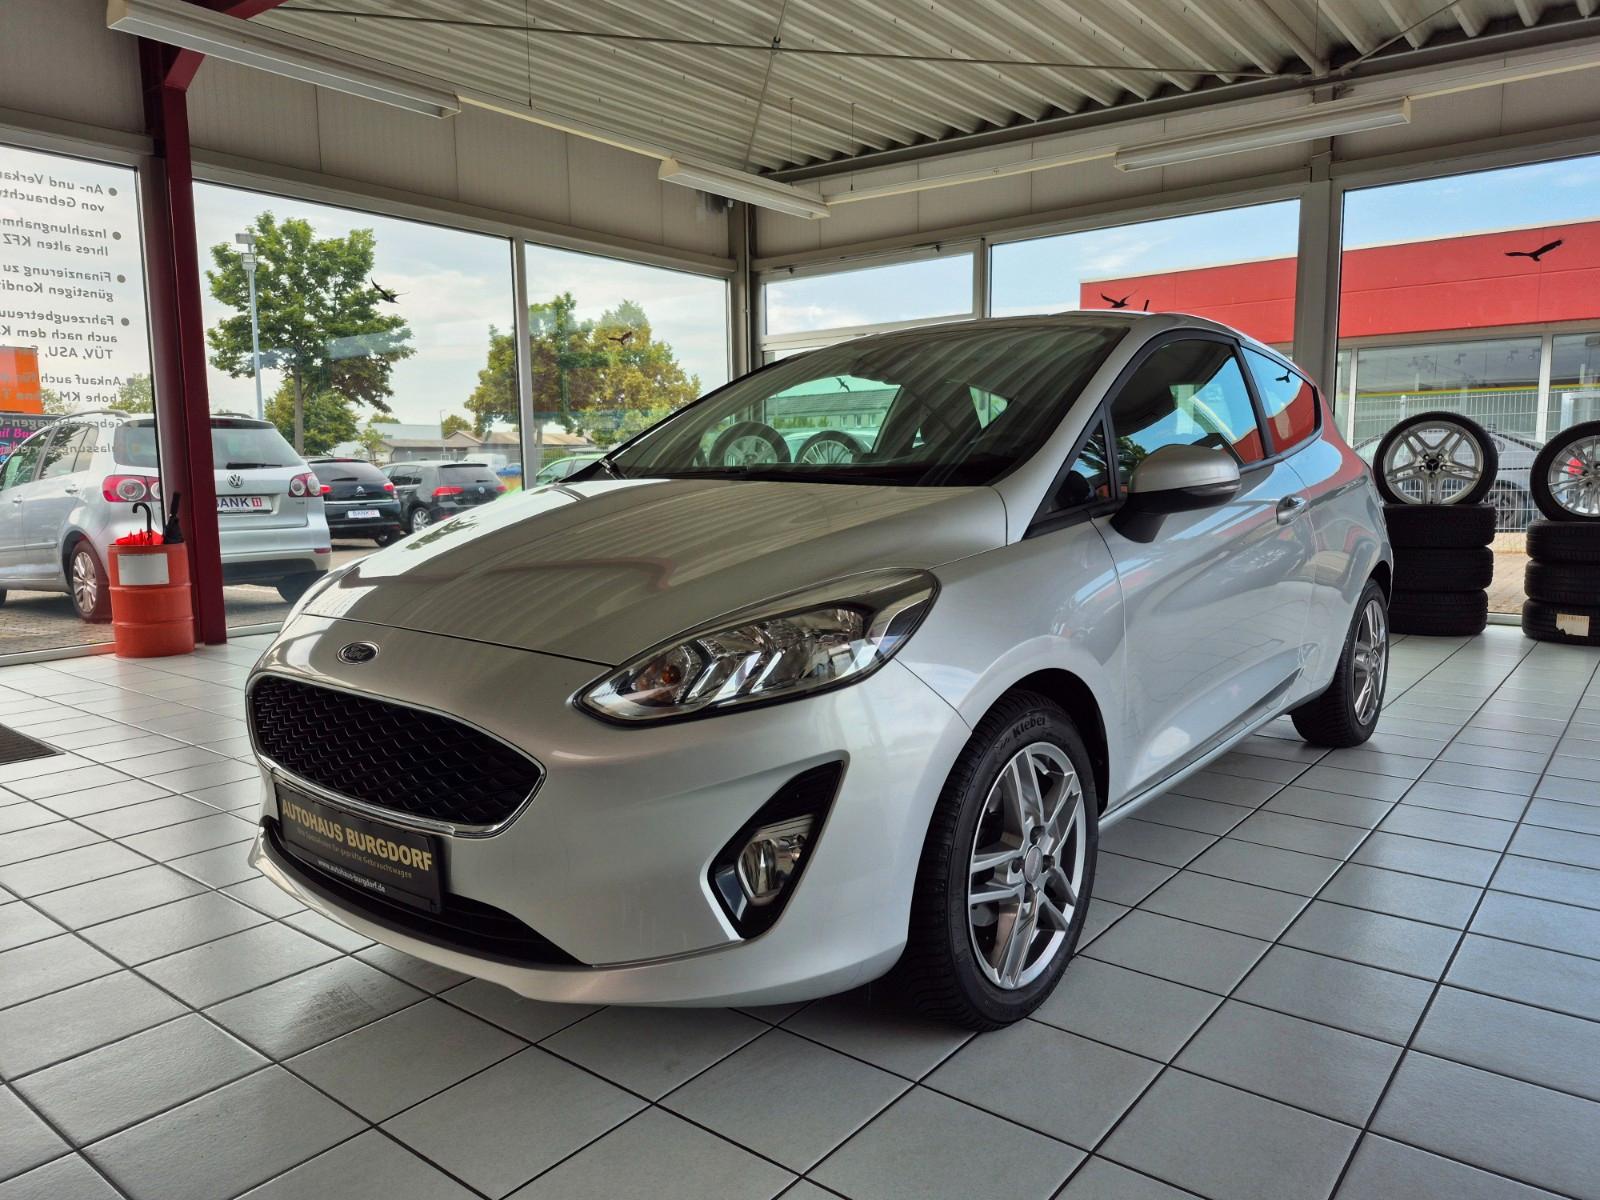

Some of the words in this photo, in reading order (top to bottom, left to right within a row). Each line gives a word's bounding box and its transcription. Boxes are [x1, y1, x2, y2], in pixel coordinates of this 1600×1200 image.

[216, 497, 250, 508] ANK
[282, 799, 344, 843] AUTOHAUS
[346, 827, 432, 871] BURGDORF
